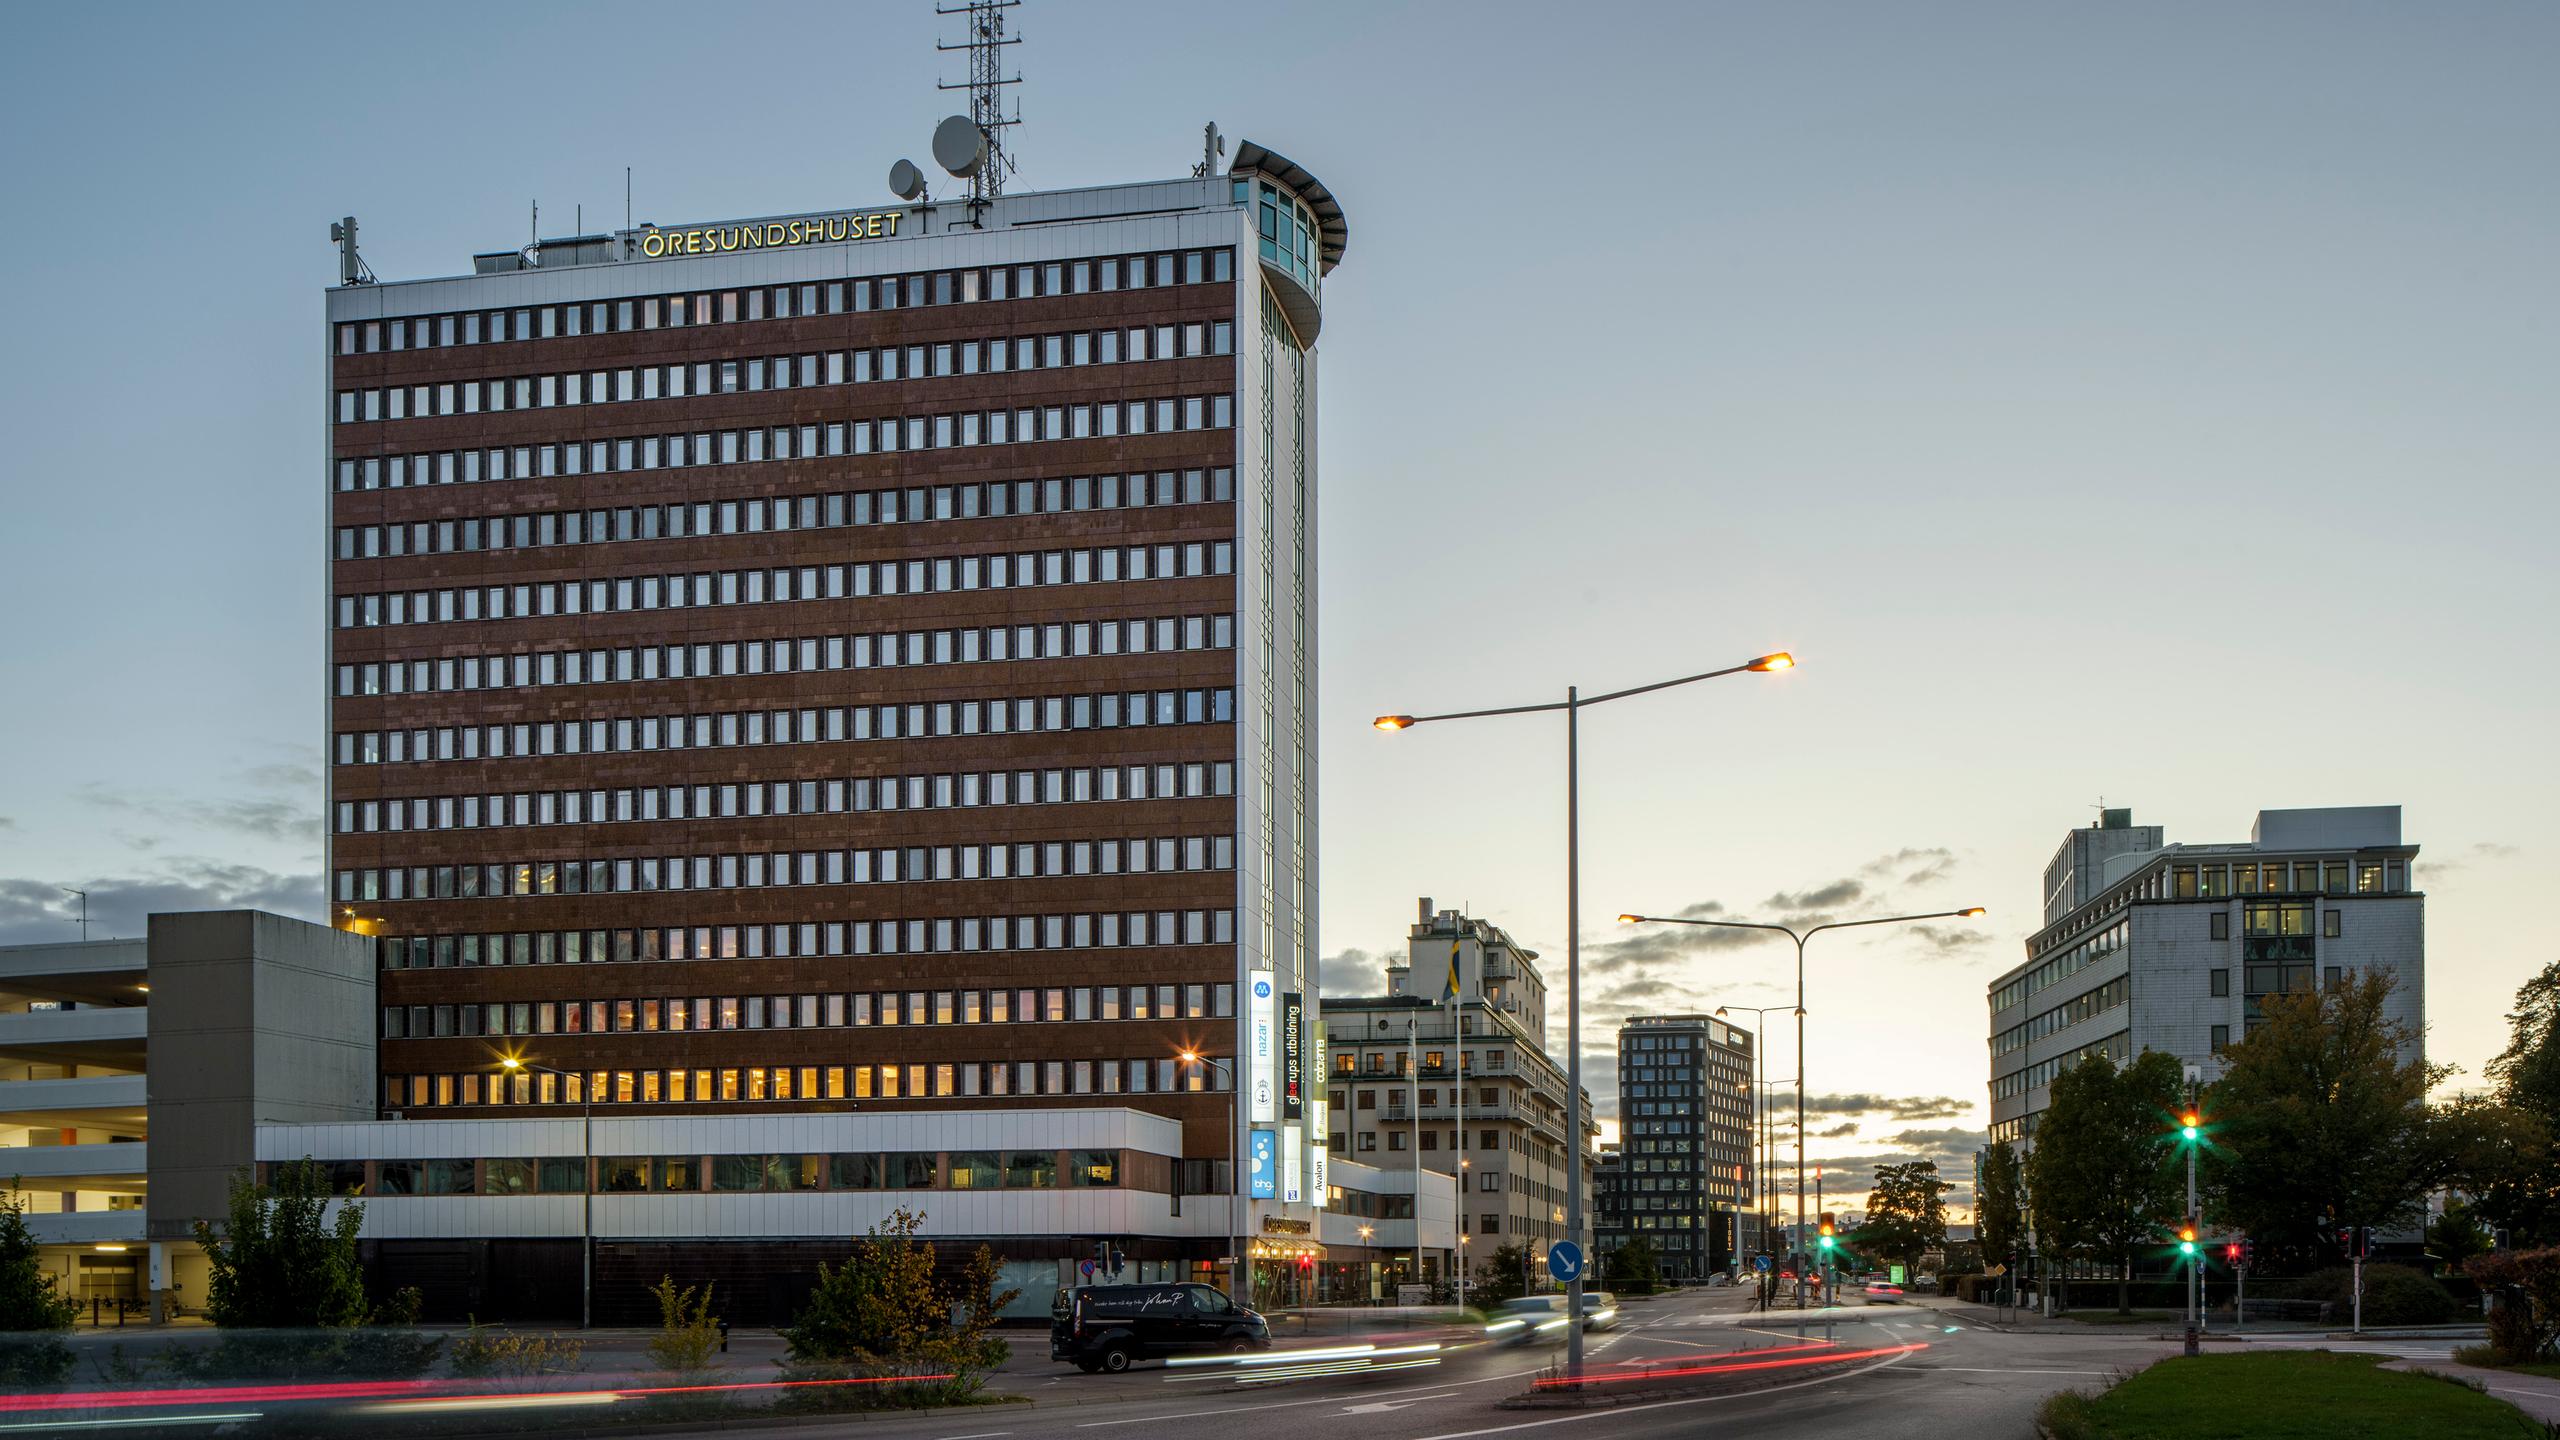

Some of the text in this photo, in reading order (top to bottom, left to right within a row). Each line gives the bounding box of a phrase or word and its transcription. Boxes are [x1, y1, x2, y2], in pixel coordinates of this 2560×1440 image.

[642, 212, 902, 258] ÖRESUNDSHUSET
[1287, 1006, 1300, 1105] gleerups utbildning
[1314, 1039, 1325, 1083] colorama
[1314, 1161, 1323, 1191] Avalon
